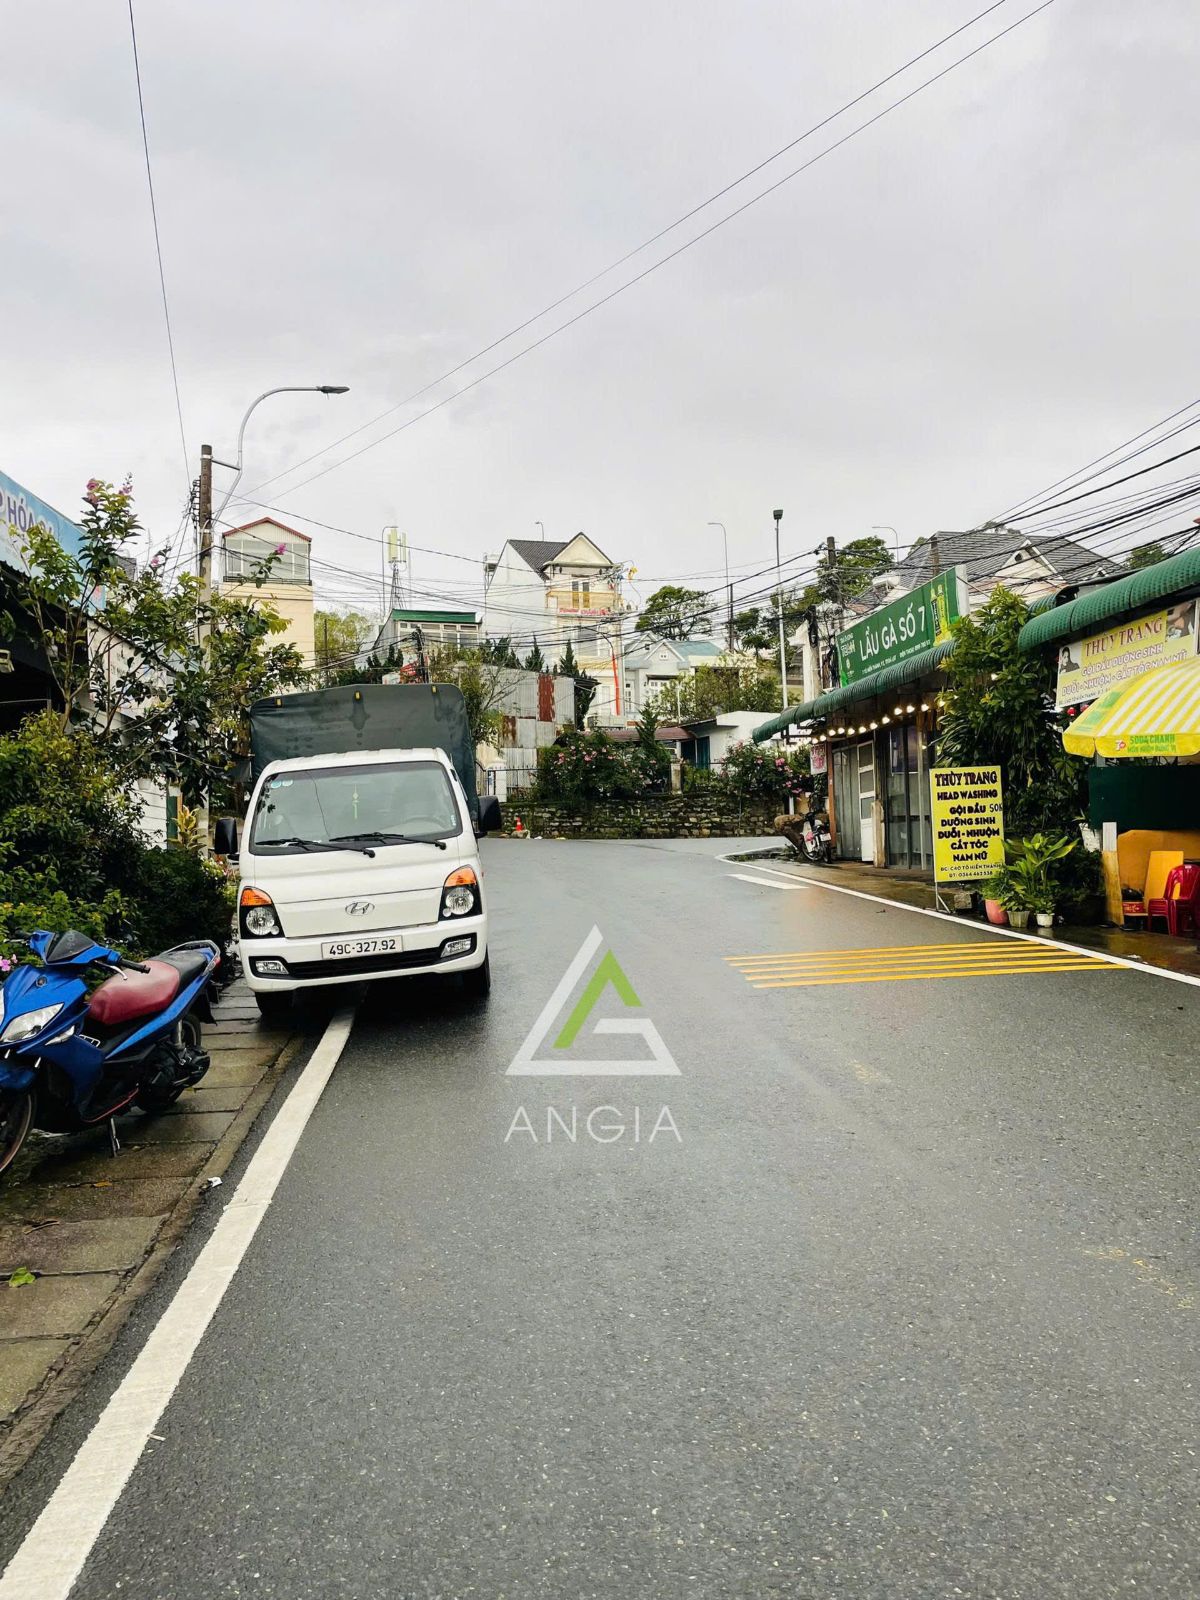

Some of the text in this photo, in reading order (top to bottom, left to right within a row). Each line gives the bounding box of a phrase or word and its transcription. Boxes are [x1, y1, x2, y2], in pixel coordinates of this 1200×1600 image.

[860, 626, 879, 661] LẨU
[881, 617, 898, 649] GÀ
[899, 602, 916, 642] SỐ
[918, 606, 925, 632] 7
[1119, 617, 1162, 645] TRANG
[1143, 642, 1164, 659] SINH
[935, 770, 998, 787] THÙY TRANG
[937, 789, 998, 801] HEAD WASHING
[974, 817, 996, 825] SINH
[969, 839, 989, 849] TÓC
[953, 854, 973, 862] NAM
